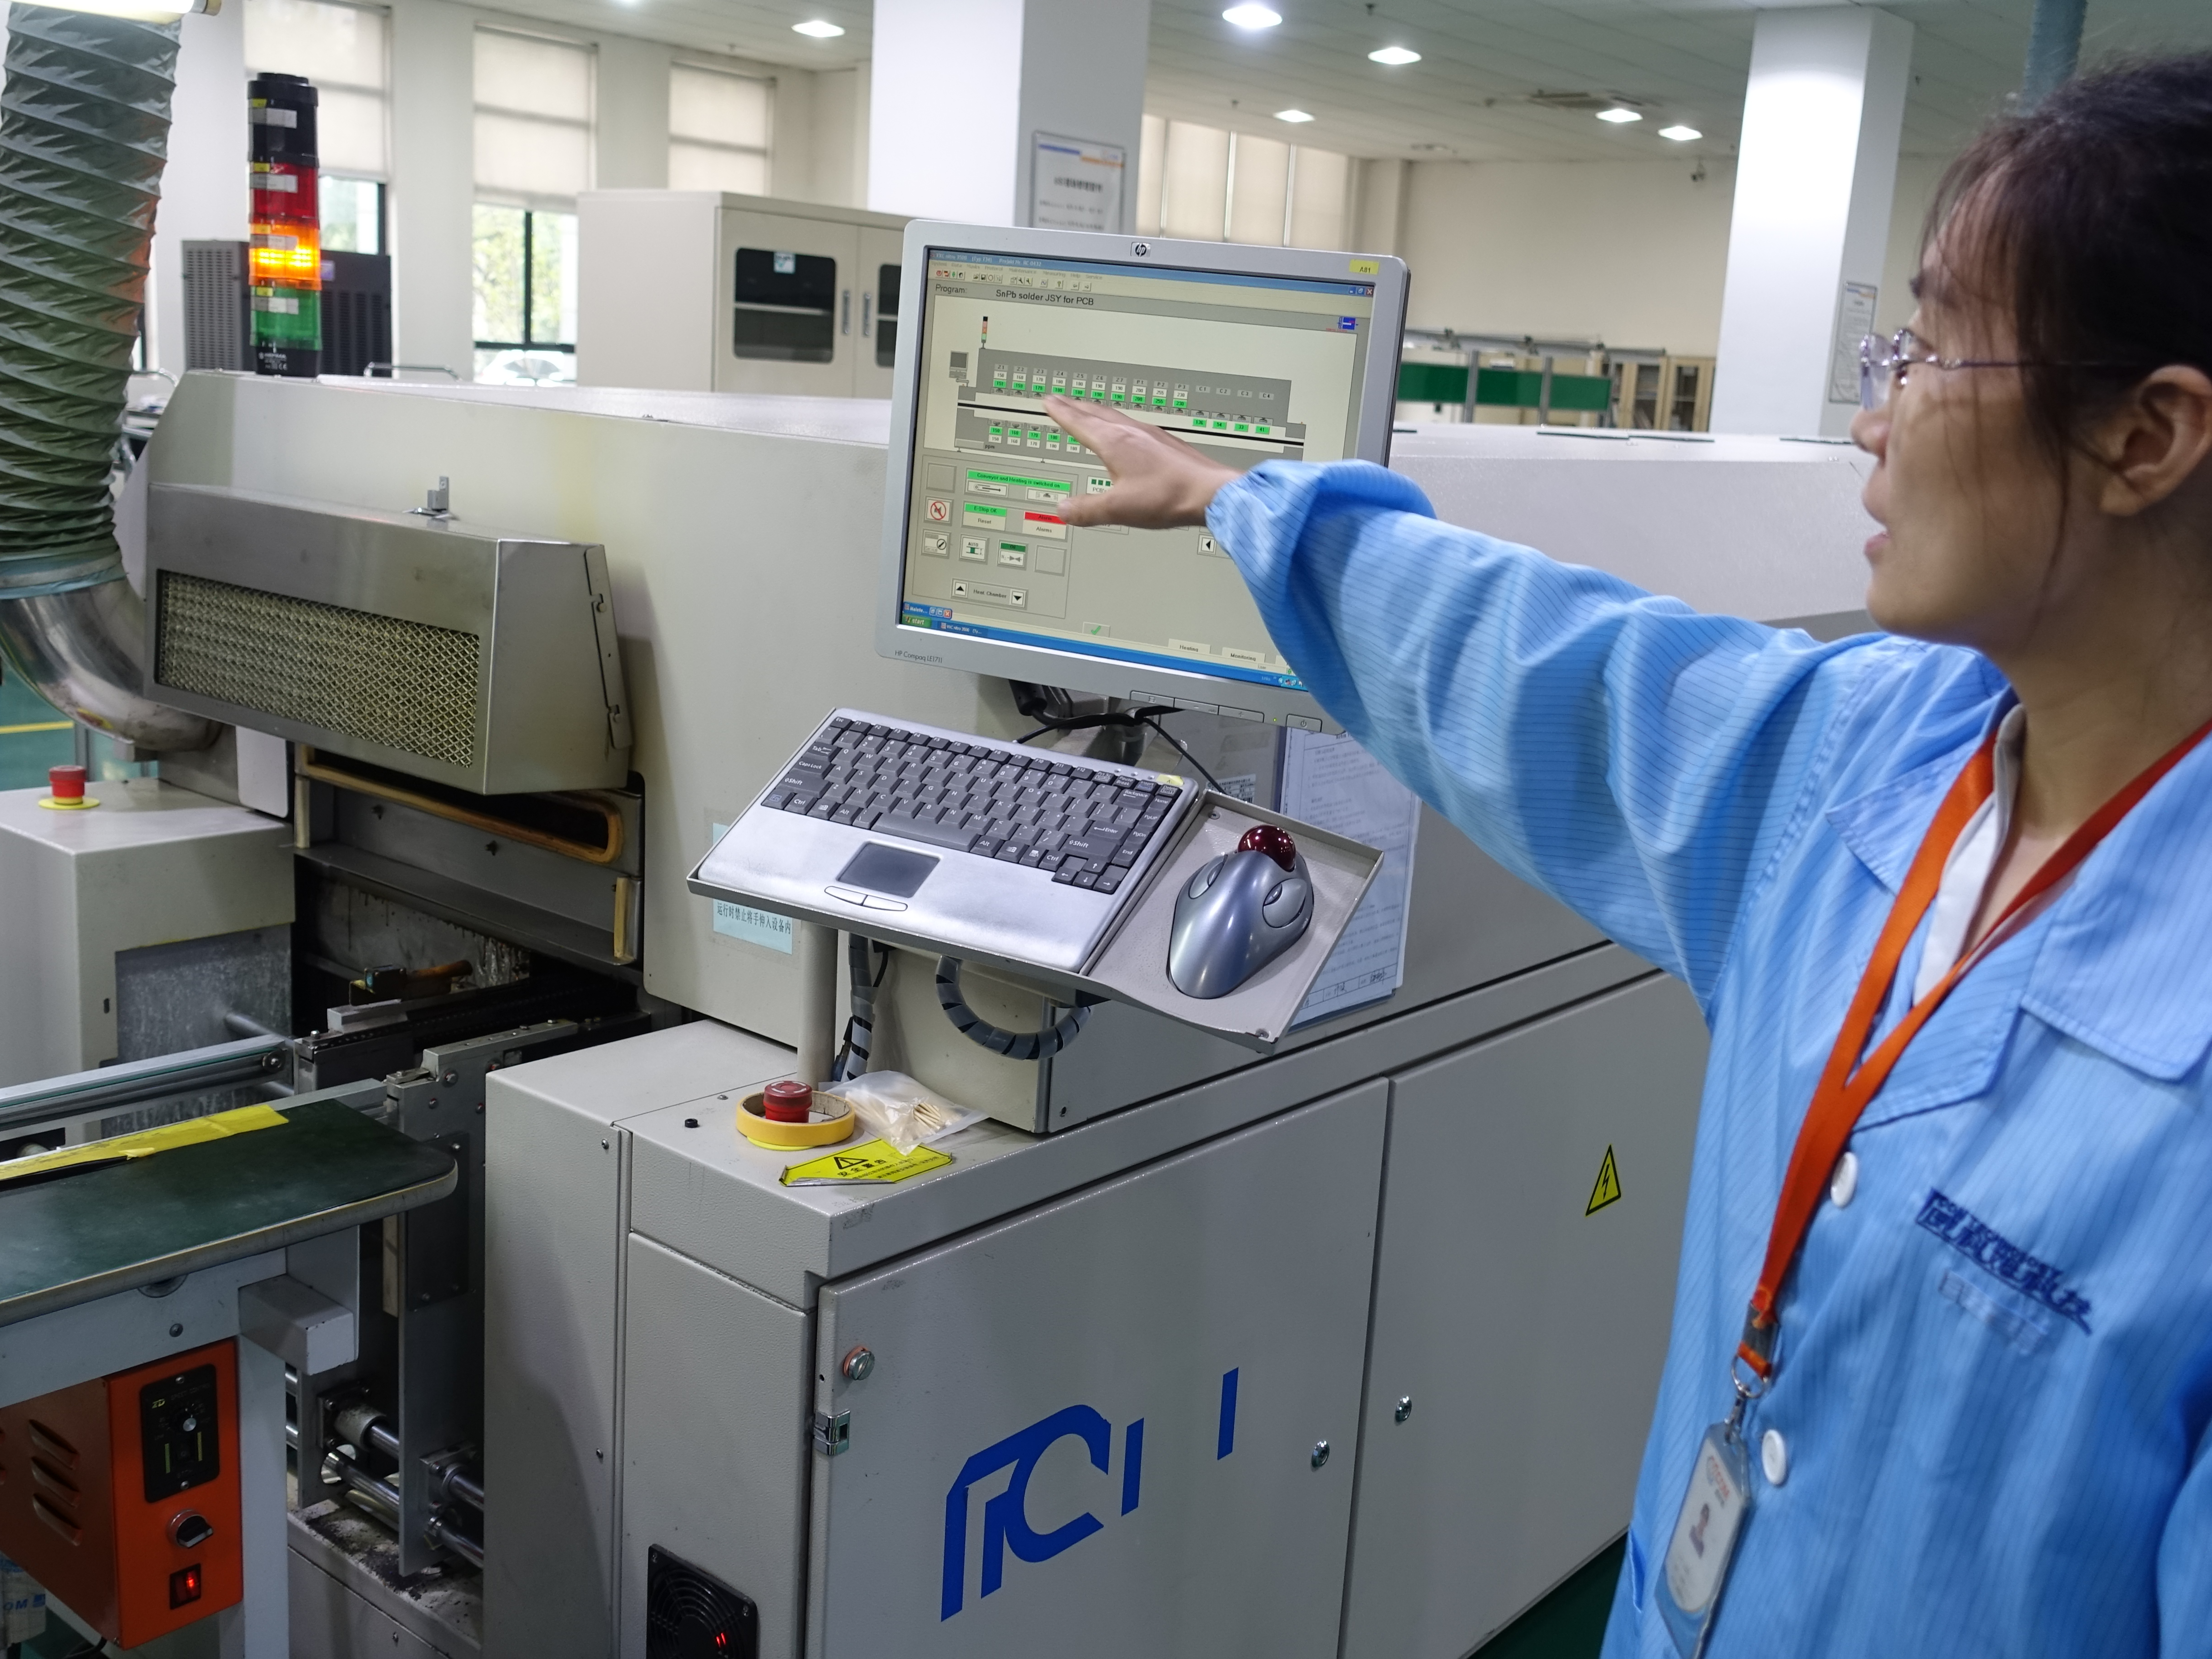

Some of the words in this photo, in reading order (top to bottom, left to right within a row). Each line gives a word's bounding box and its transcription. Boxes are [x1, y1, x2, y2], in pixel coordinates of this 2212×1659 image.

[935, 284, 967, 294] Program:
[996, 290, 1016, 298] SnPb
[1076, 297, 1093, 305] PCB
[904, 651, 925, 662] Compaq
[1231, 653, 1256, 661] Monitoring
[717, 902, 791, 935] 运行时禁止将手伸入设备内
